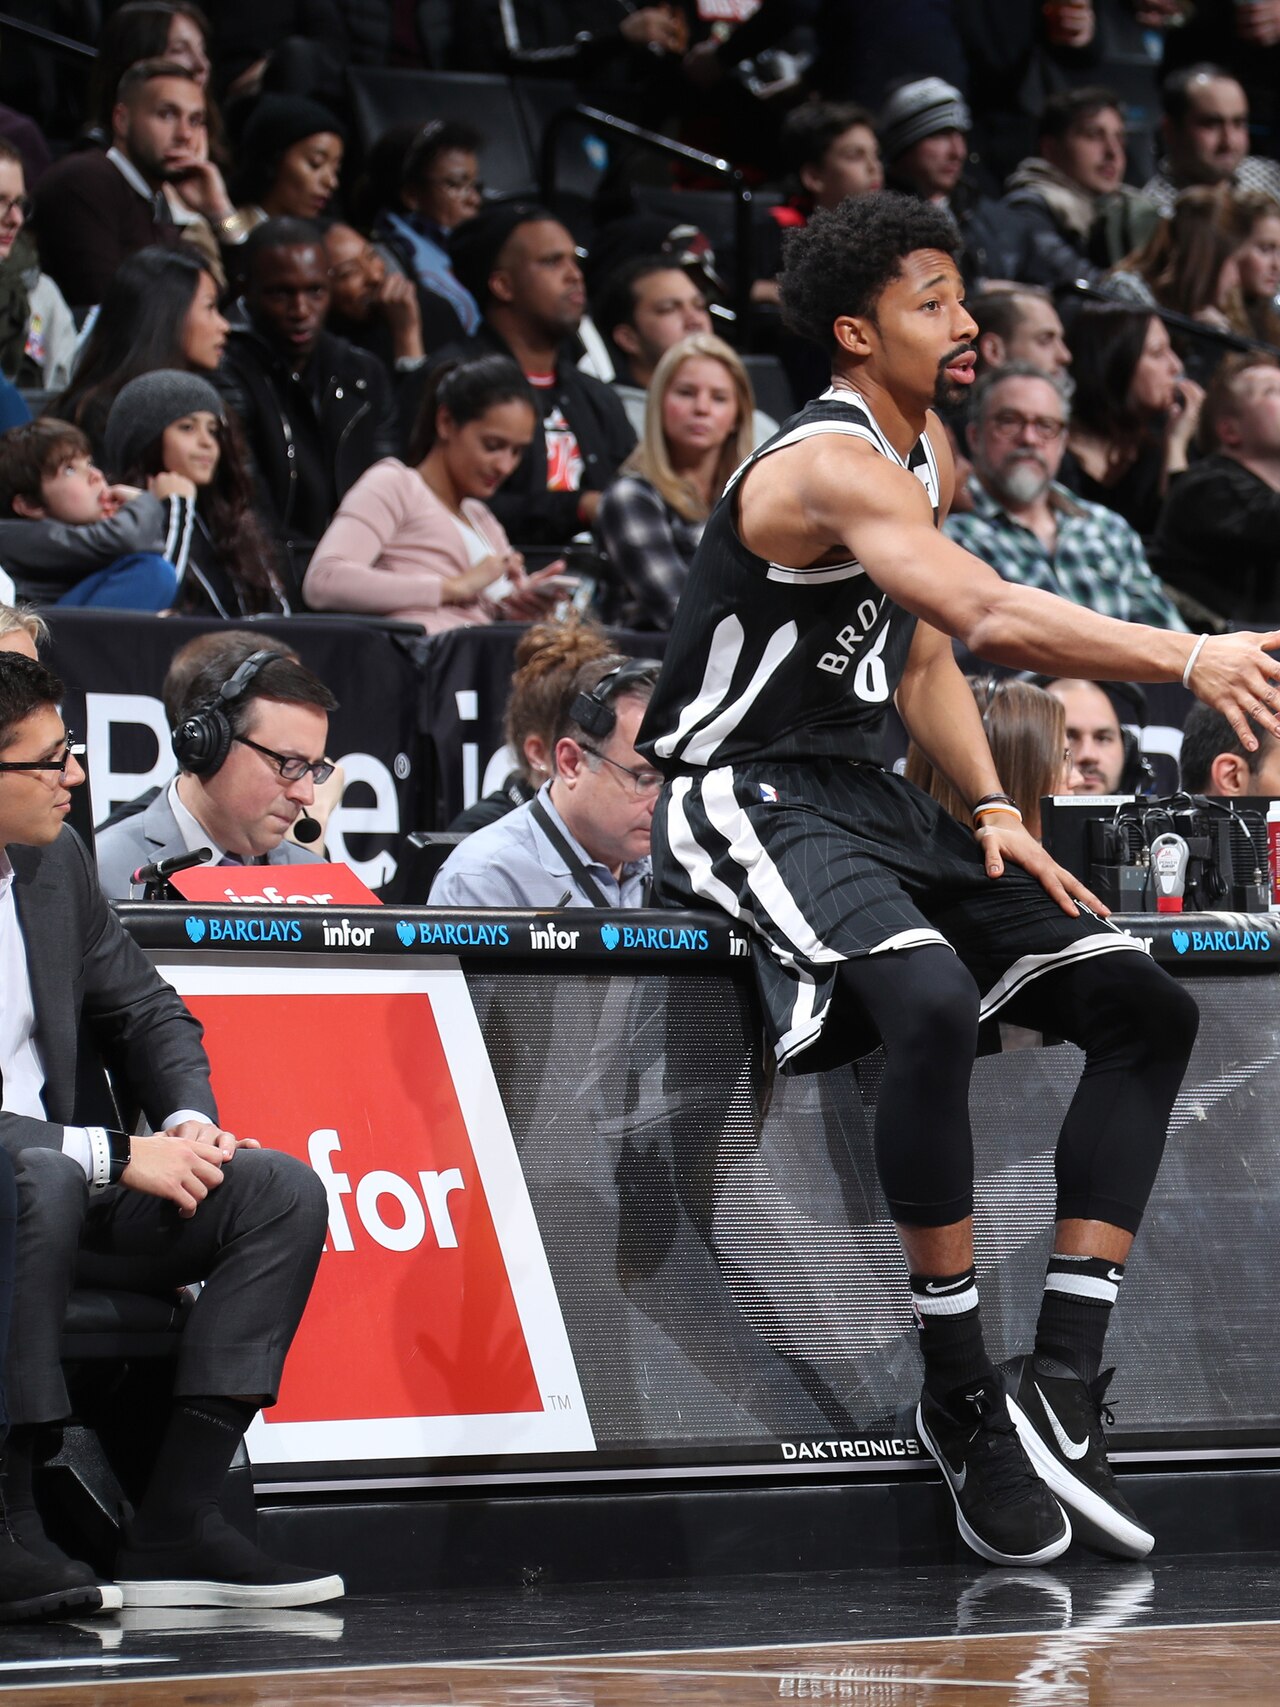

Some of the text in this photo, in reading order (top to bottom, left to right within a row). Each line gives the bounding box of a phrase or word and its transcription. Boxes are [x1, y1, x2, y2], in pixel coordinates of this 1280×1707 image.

[209, 918, 303, 943] BARCLAYS
[323, 918, 375, 947] infor
[419, 921, 510, 947] BARCLAYS
[528, 922, 580, 950] infor
[622, 927, 709, 951] BARCLAYS
[1192, 930, 1271, 952] BARCLAYS
[307, 1128, 466, 1253] for
[547, 1394, 571, 1411] TM
[781, 1439, 920, 1459] DAKTRONICS
